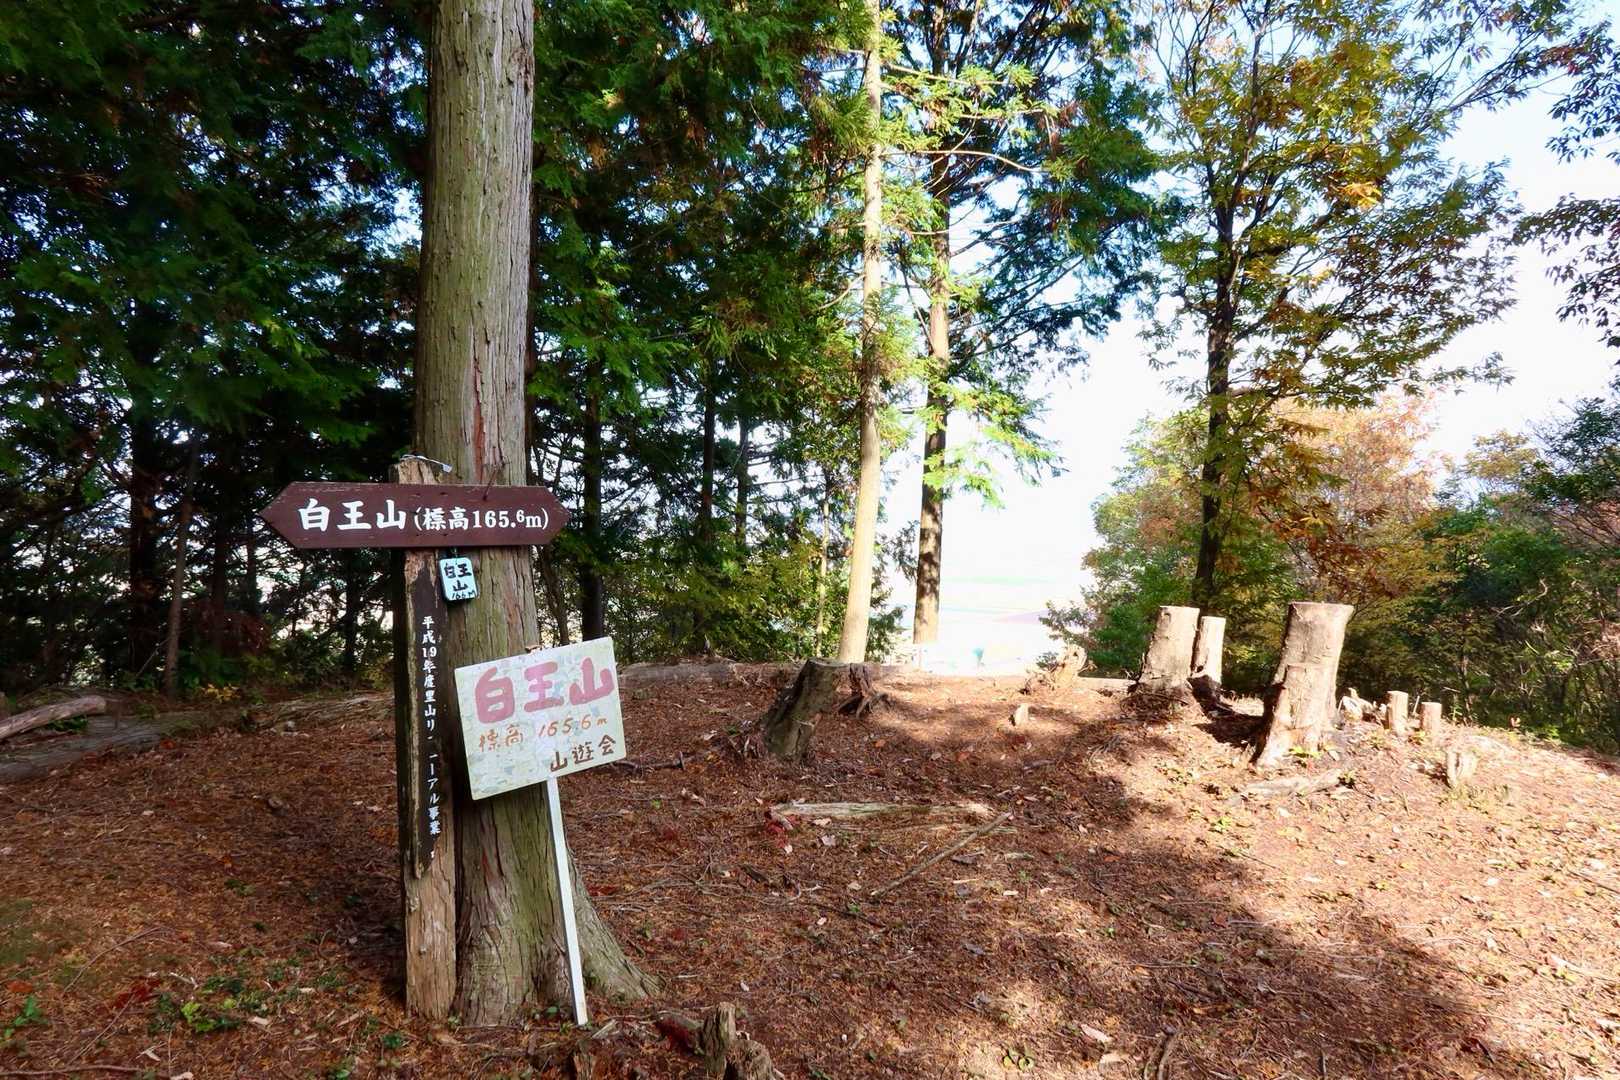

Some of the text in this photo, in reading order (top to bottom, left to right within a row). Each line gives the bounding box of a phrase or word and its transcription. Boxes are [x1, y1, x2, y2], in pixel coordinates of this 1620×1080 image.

[475, 657, 614, 724] 白王山
[551, 734, 616, 772] 山遊会
